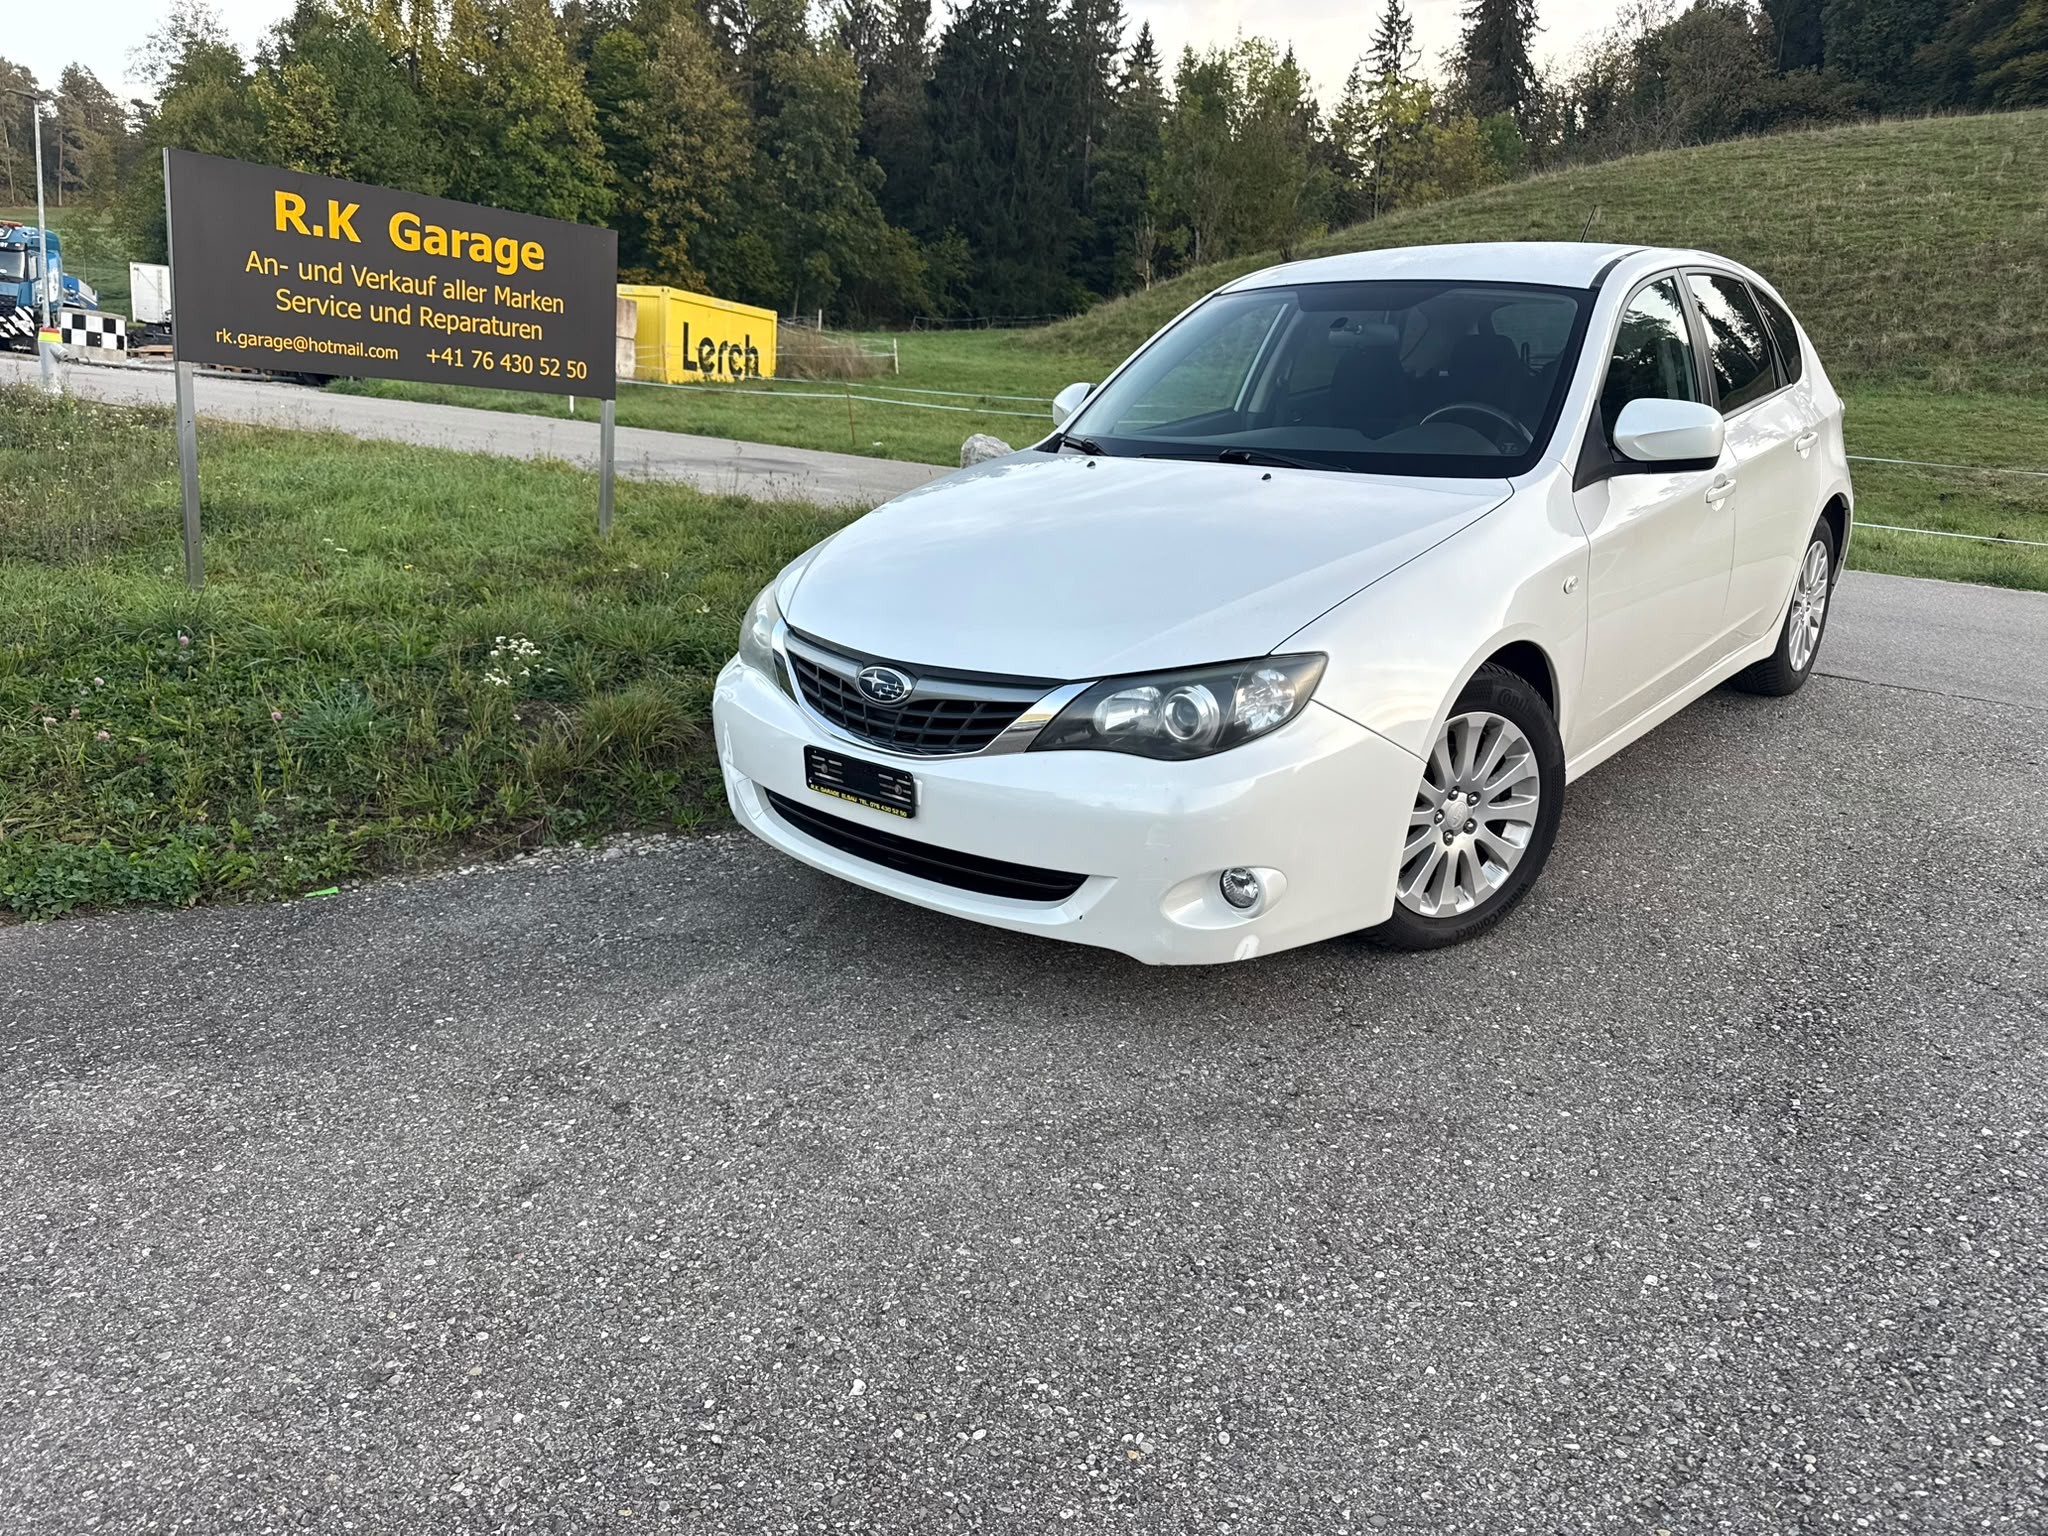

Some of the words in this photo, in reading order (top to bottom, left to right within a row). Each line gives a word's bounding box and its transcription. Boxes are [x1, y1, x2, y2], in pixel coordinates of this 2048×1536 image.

[274, 189, 362, 243] R.K
[388, 211, 546, 277] Garage
[245, 250, 290, 277] An-
[298, 262, 343, 285] und
[350, 265, 437, 296] Verkauf
[442, 278, 488, 305] aller
[493, 285, 566, 314] Marken
[275, 288, 362, 320] Service
[369, 302, 413, 327] und
[419, 305, 543, 340] Reparaturen
[215, 329, 399, 360] rk.garage@hotmail.com
[425, 348, 465, 368] +41
[471, 349, 496, 371] 76
[499, 353, 534, 376] 430
[538, 356, 562, 377] 52
[566, 358, 588, 380] 50
[682, 321, 761, 378] Lerch
[820, 786, 840, 798] GARAGE
